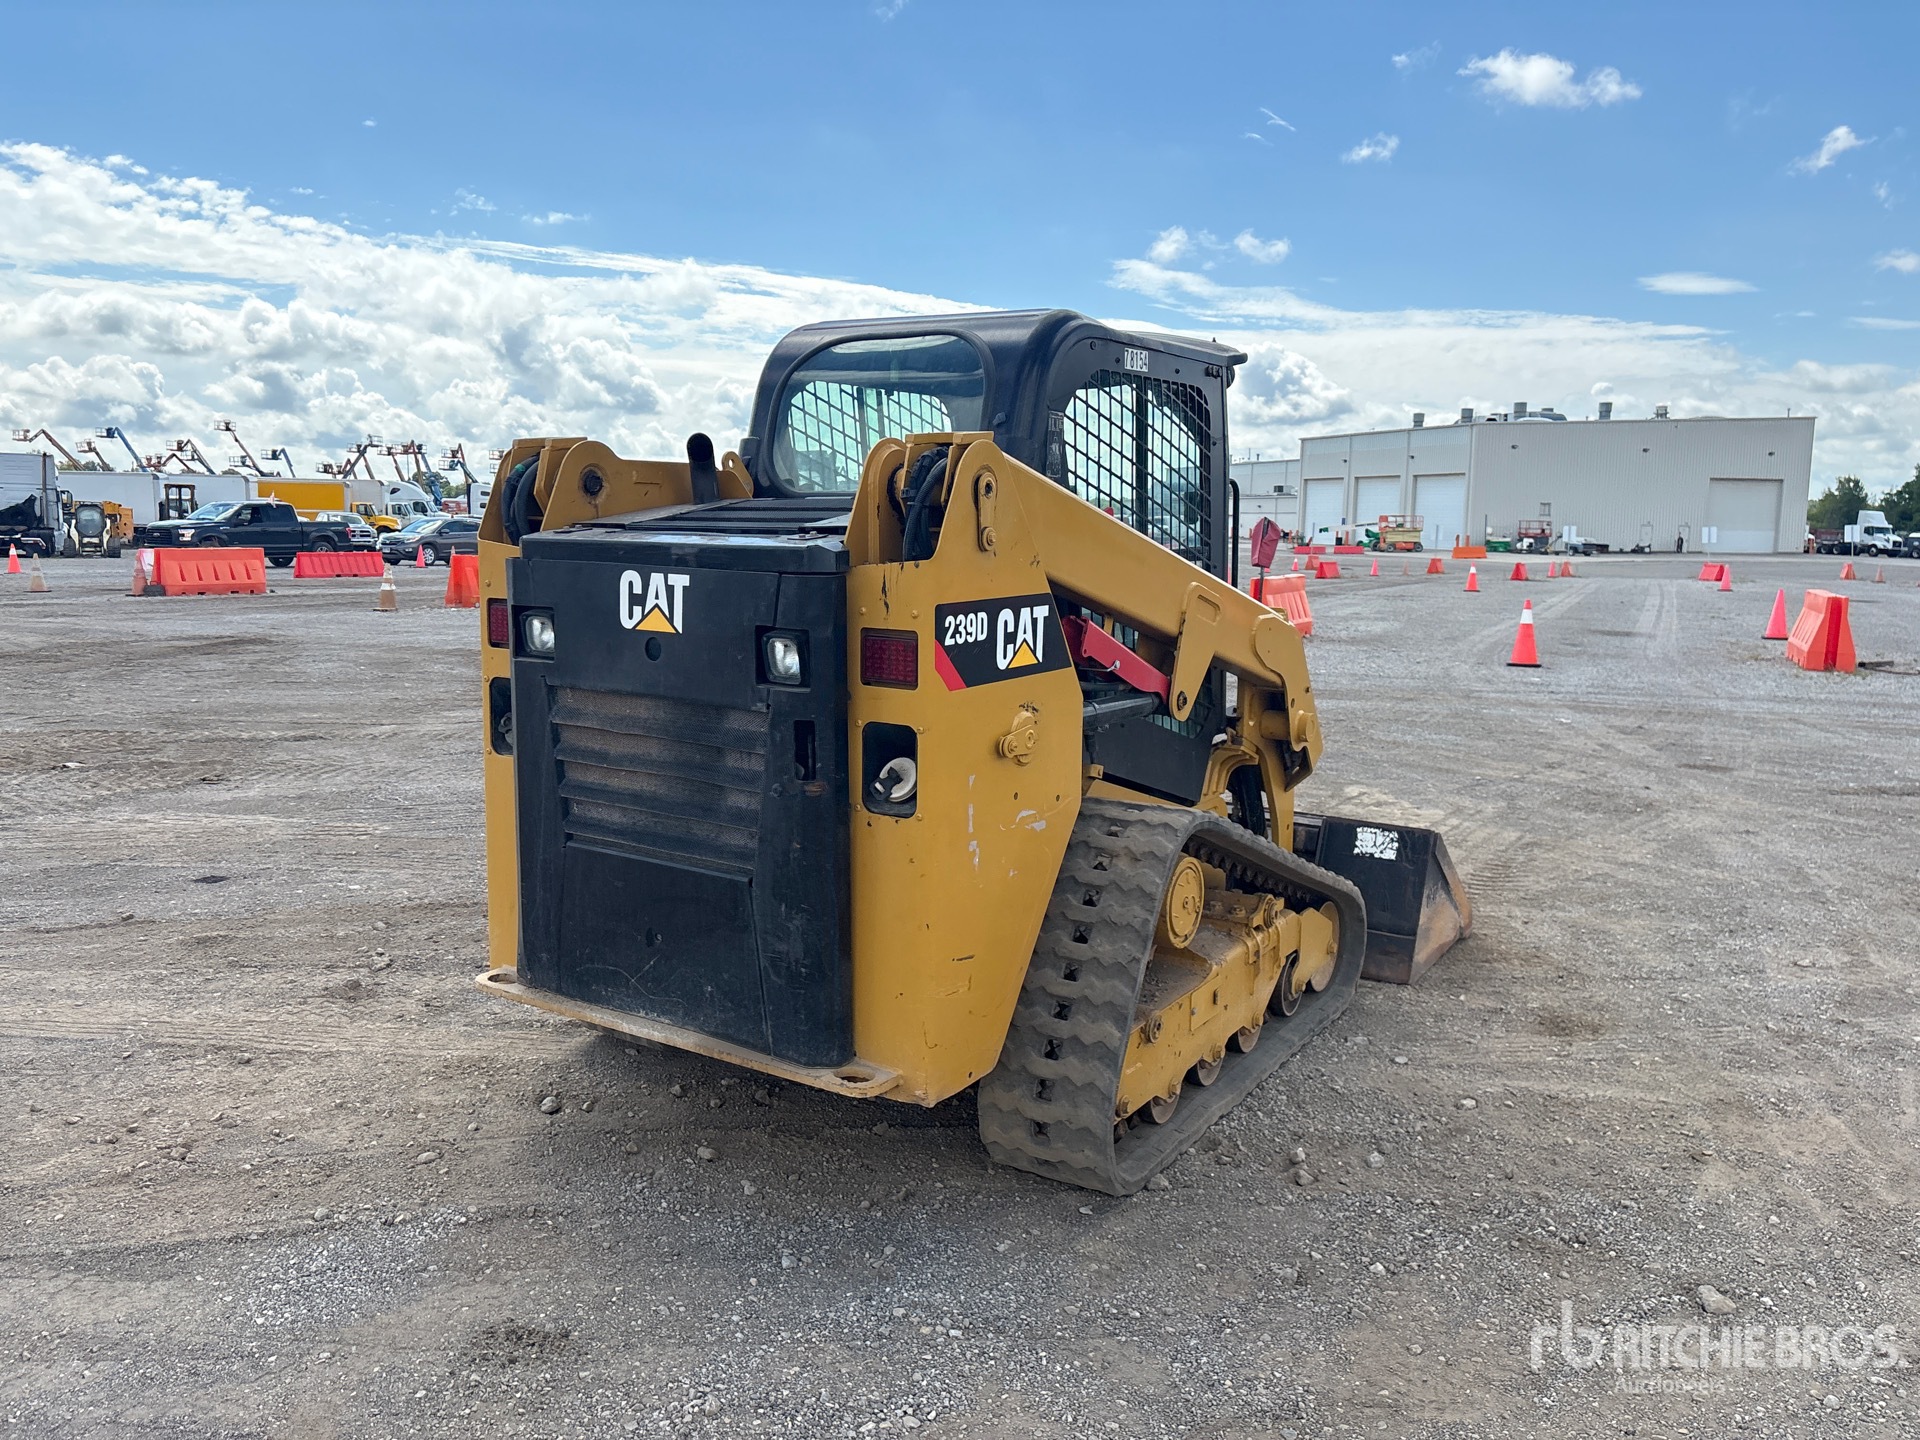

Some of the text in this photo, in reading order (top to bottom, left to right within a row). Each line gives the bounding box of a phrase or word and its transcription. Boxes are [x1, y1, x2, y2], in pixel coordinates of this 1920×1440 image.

[1125, 349, 1147, 370] 78154
[619, 569, 690, 634] CAT
[944, 604, 1050, 670] 239D CAT
